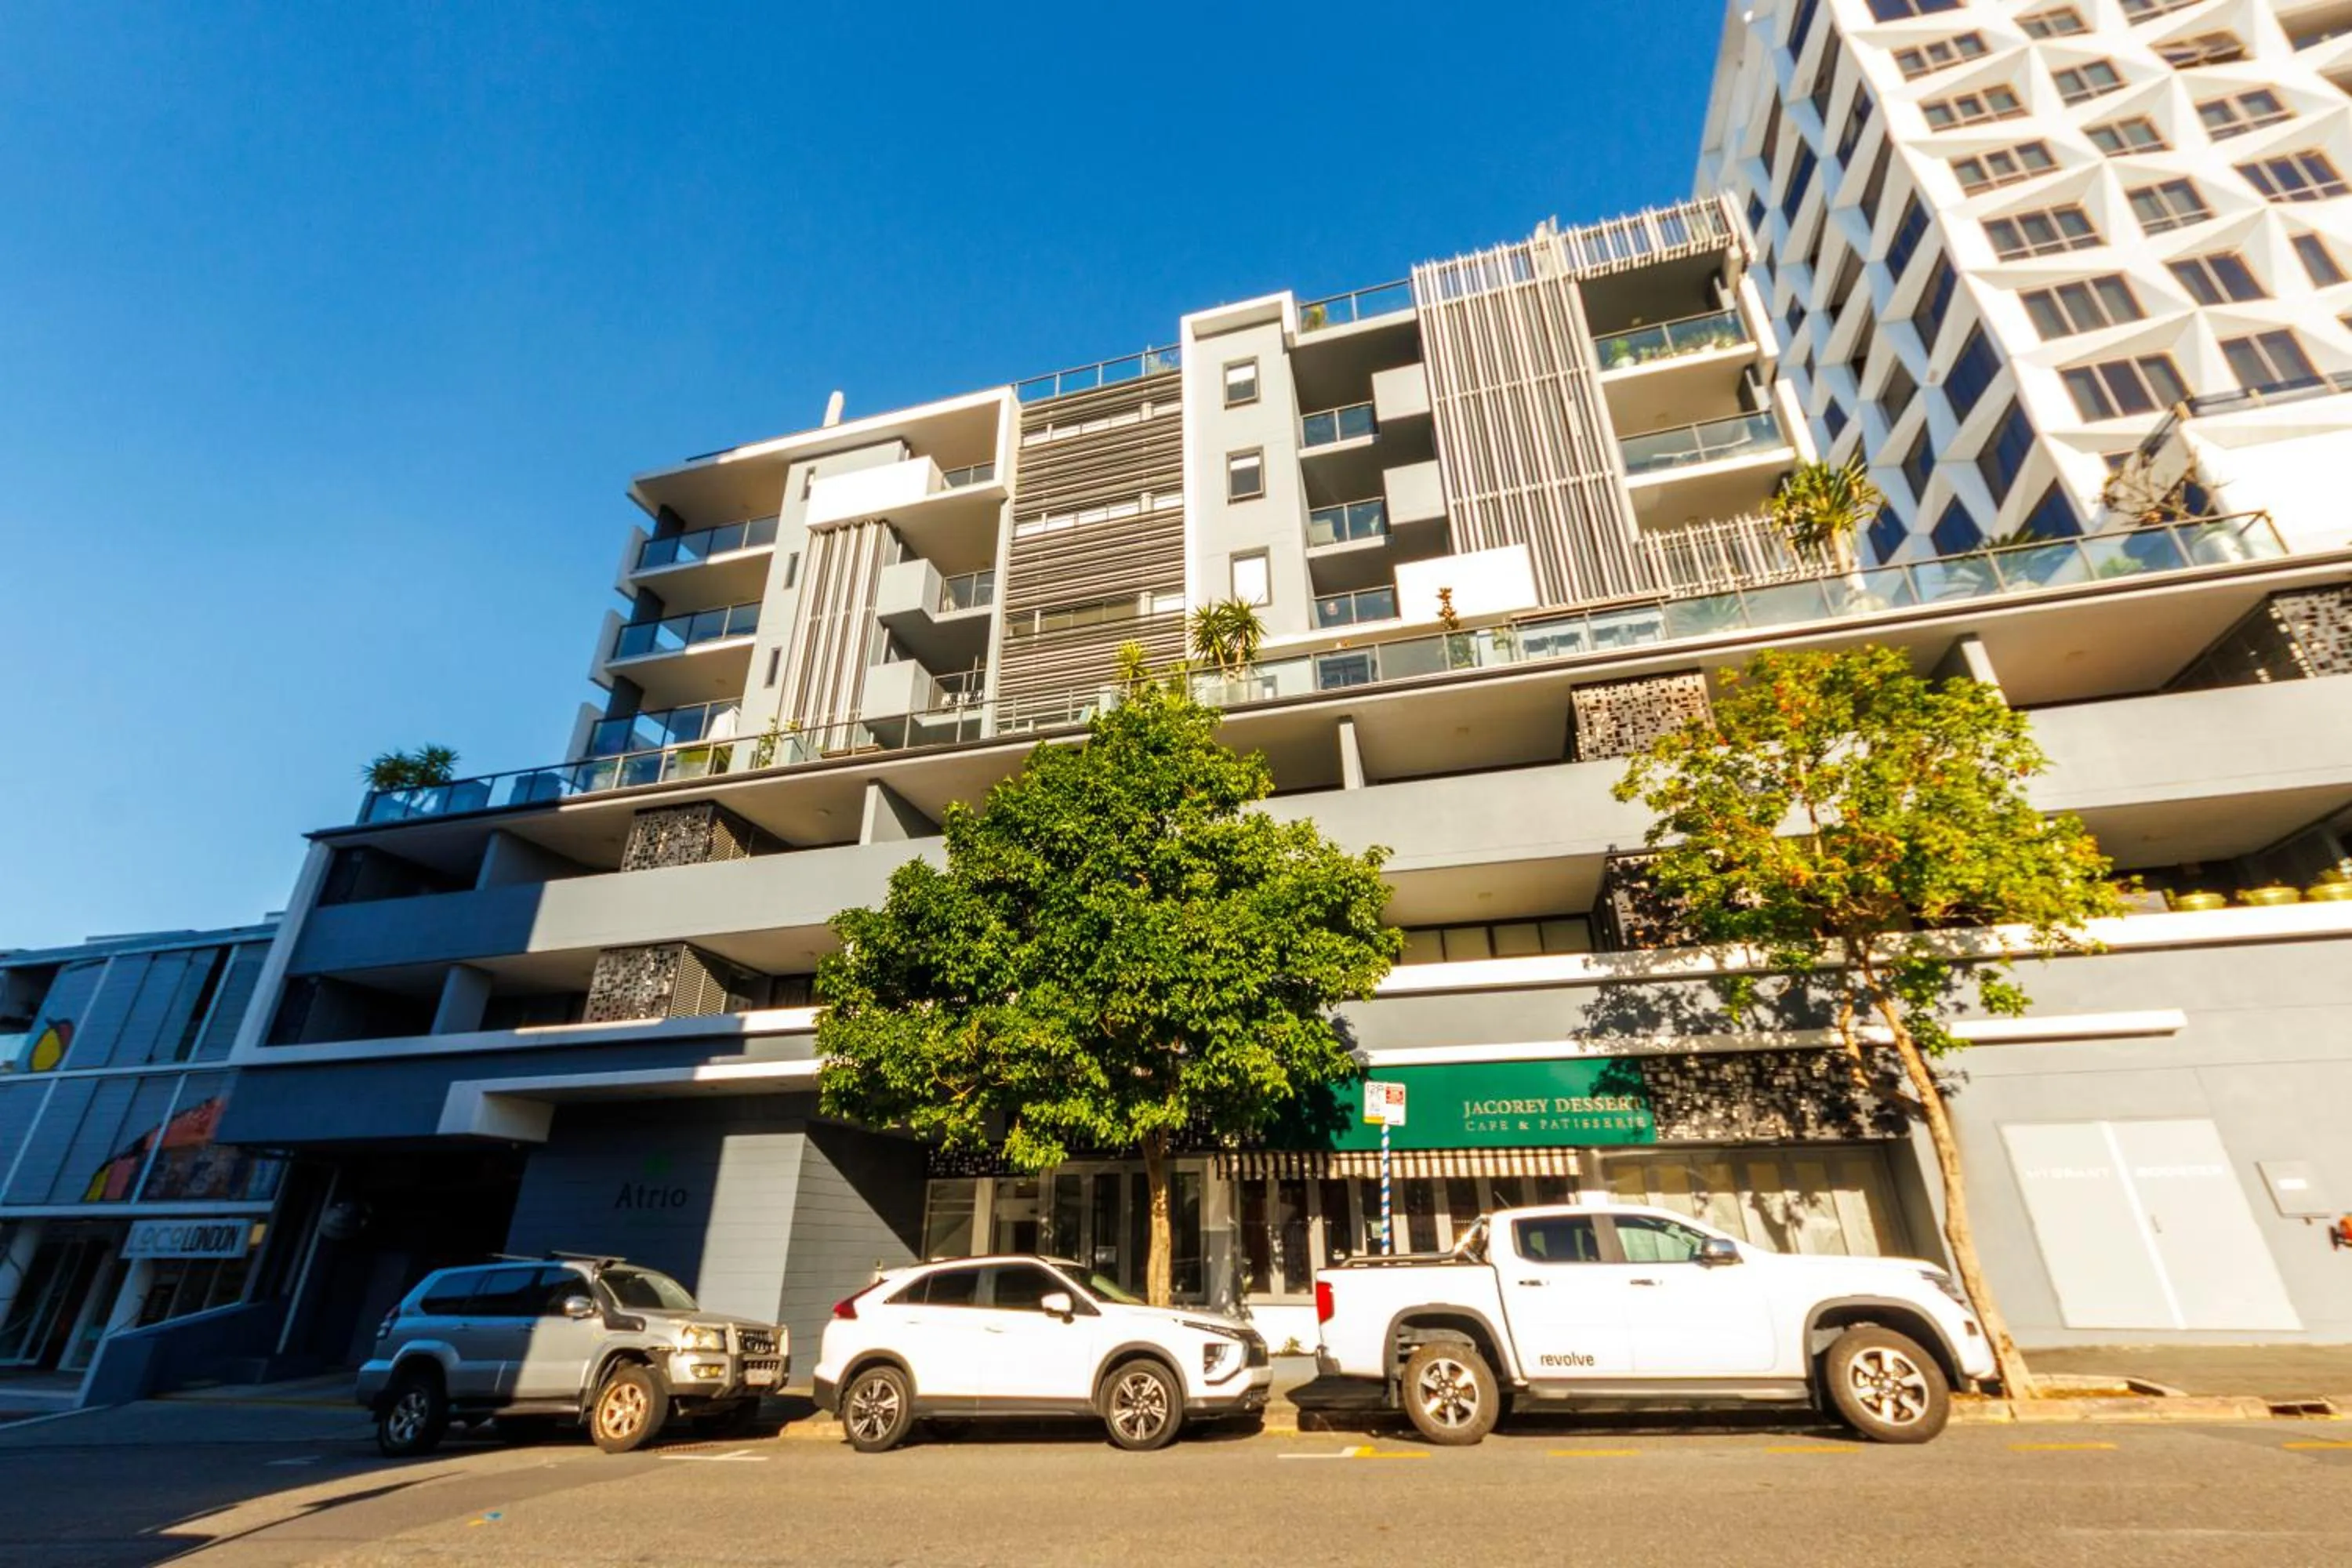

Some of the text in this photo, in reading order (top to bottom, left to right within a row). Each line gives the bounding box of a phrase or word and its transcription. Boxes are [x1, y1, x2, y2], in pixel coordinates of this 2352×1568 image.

[1463, 1095, 1646, 1119] JACOREY DESSERT
[1465, 1116, 1647, 1131] CAFE & PATISSERIE
[614, 1181, 688, 1209] Atrio
[1540, 1350, 1595, 1367] revolve
